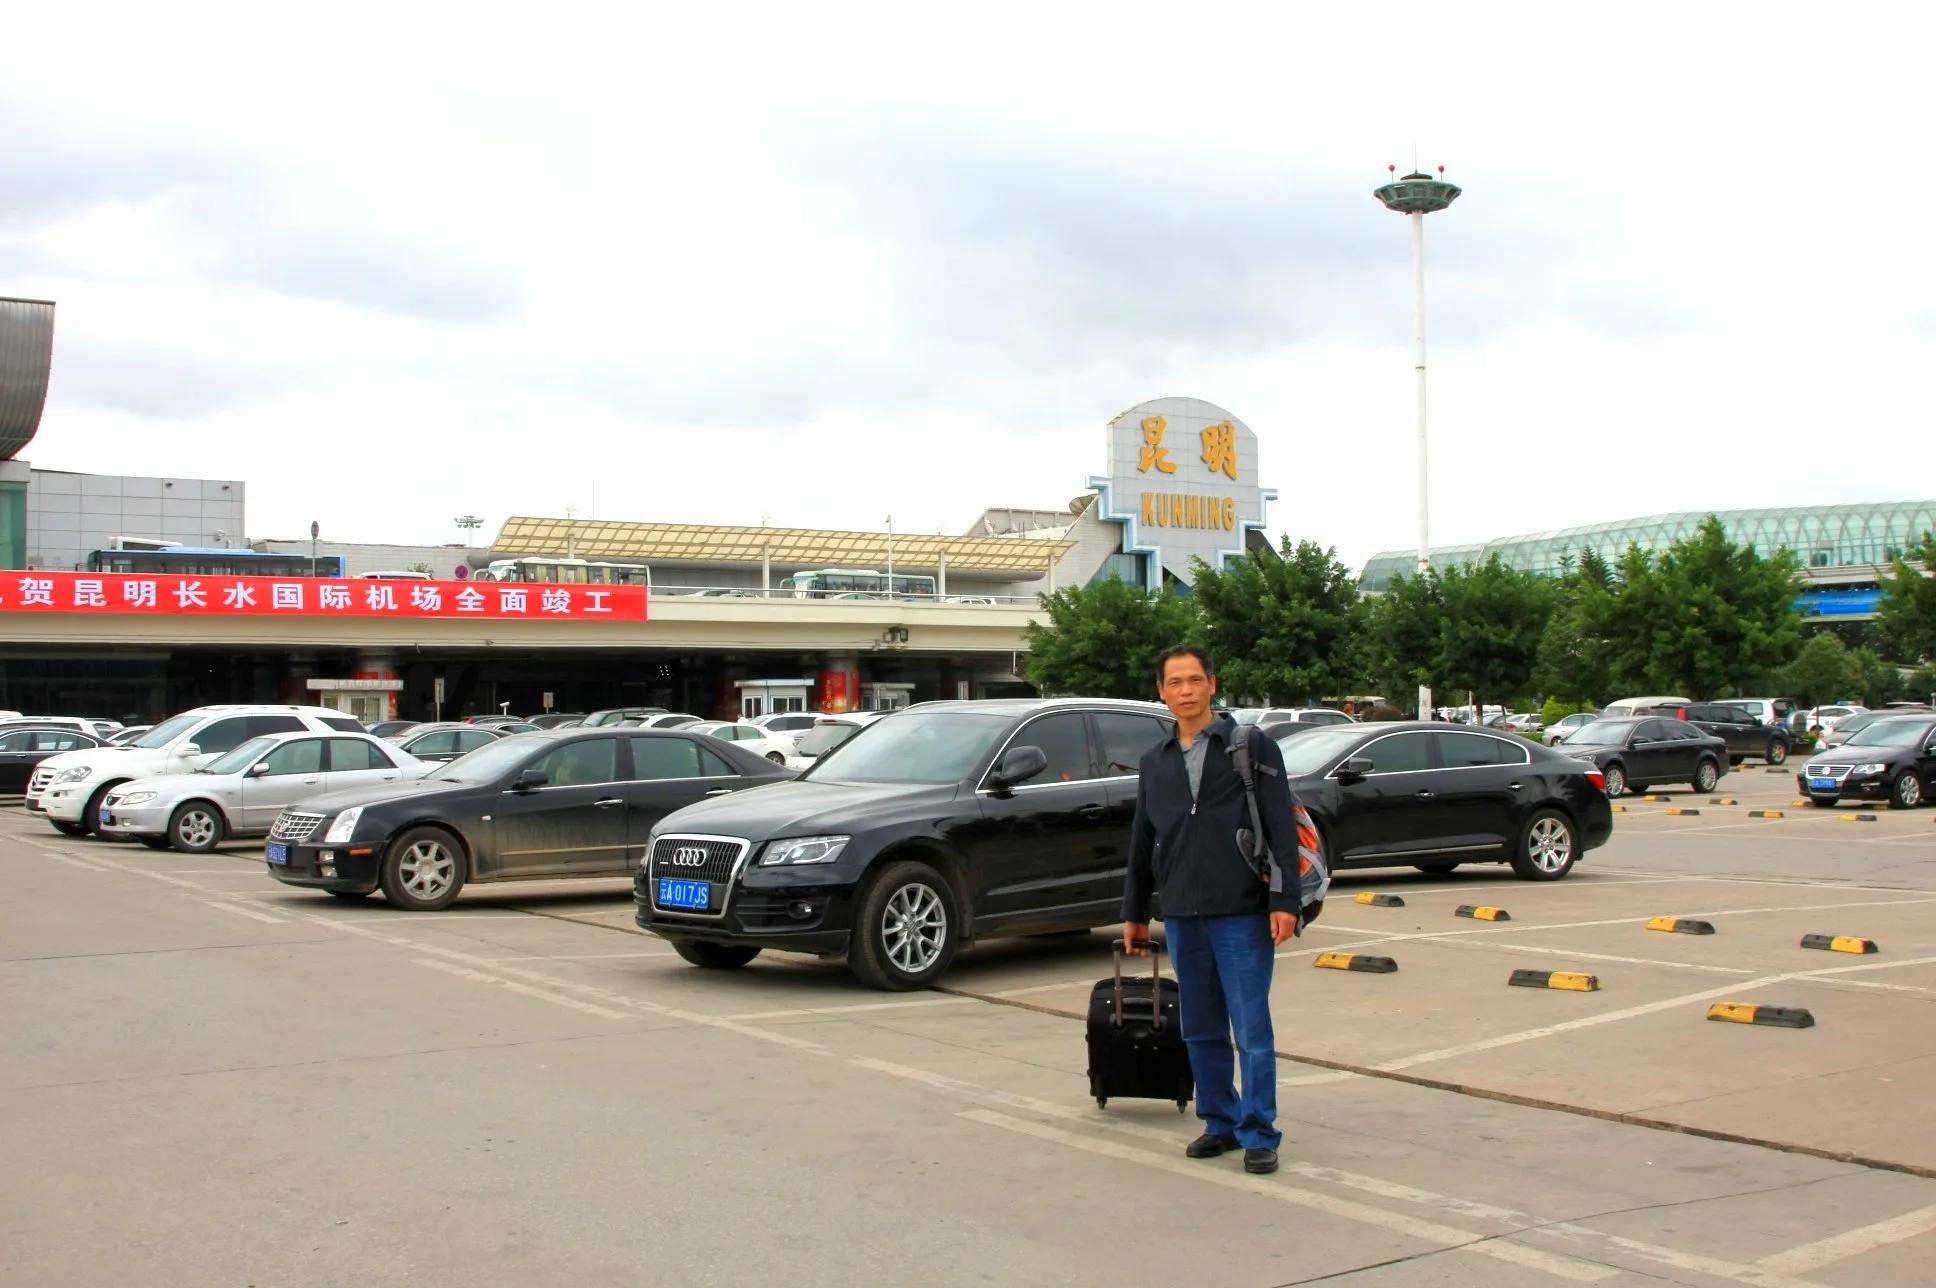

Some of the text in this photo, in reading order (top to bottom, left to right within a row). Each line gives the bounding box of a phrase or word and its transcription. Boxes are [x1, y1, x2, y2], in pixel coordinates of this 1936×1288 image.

[1138, 415, 1237, 480] 昆明
[1142, 493, 1236, 531] KUNMING
[0, 577, 612, 613] 贺昆明长水国际机场全面竣工
